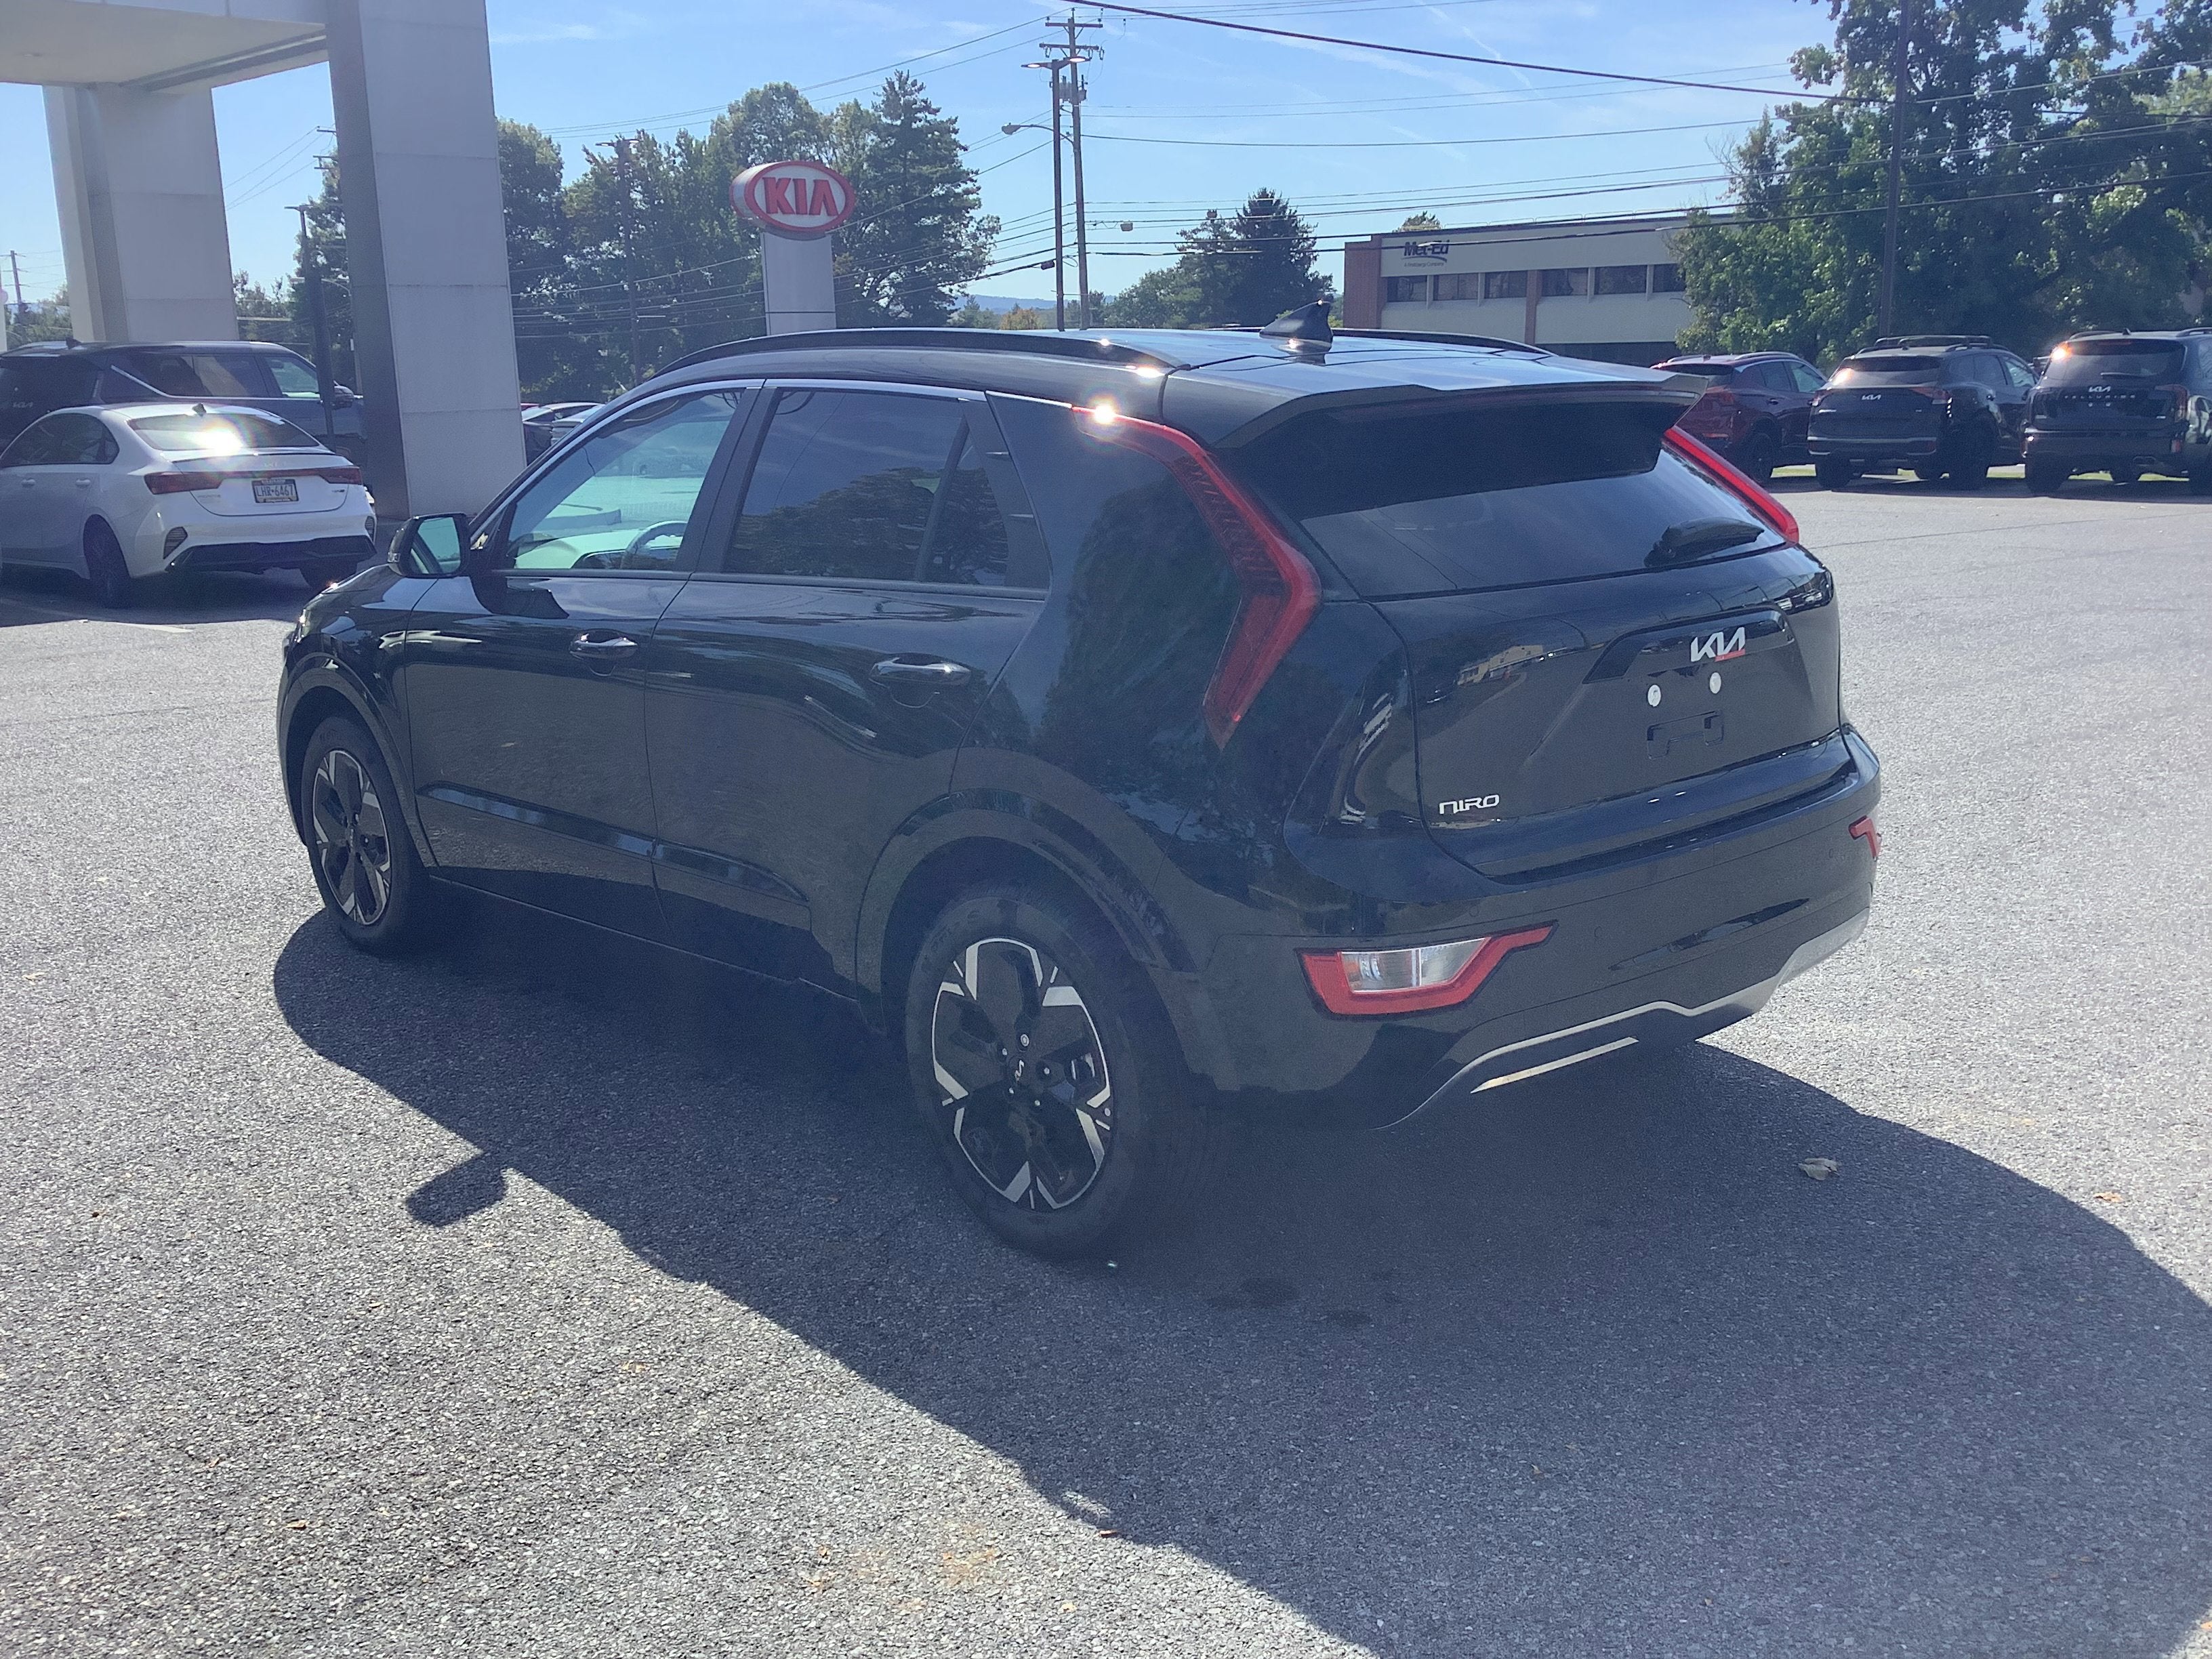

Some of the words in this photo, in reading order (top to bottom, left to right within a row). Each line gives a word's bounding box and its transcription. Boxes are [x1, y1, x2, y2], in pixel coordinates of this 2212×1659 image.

[762, 176, 840, 216] KIA
[1690, 627, 1746, 662] KIA
[1439, 794, 1500, 815] NIRO
